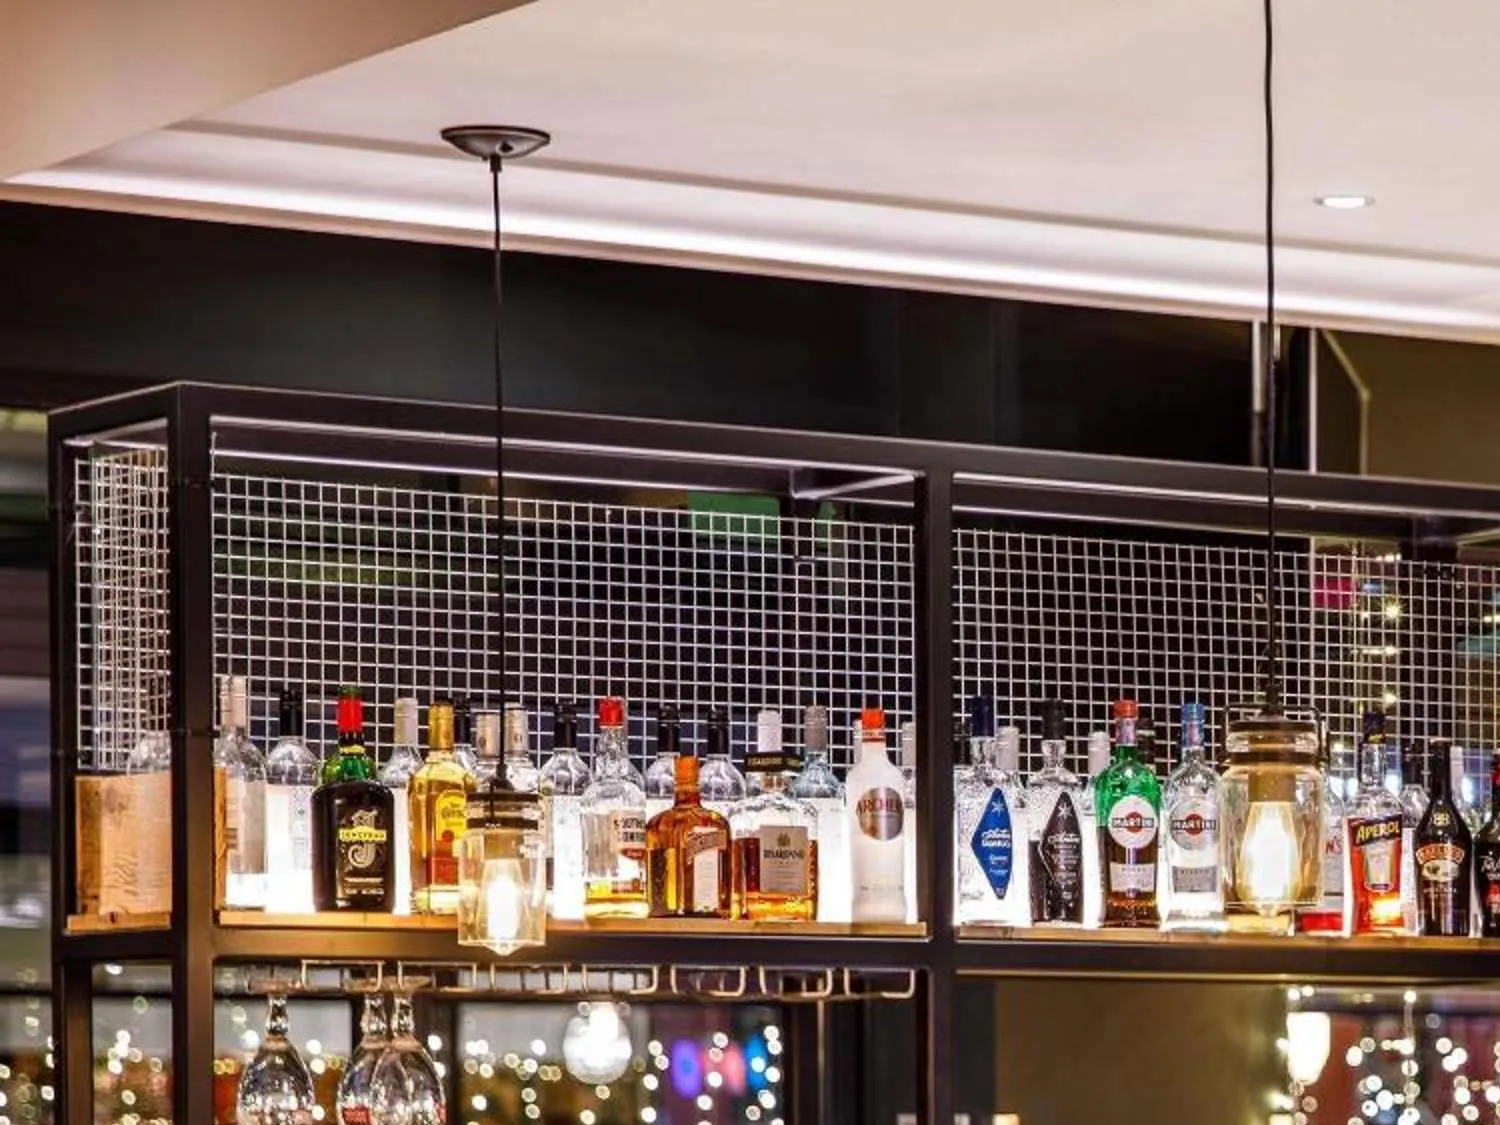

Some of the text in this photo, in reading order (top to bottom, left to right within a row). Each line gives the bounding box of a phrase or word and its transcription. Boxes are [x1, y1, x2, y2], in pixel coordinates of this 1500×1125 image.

[1112, 817, 1155, 829] MARTINI
[1171, 819, 1217, 830] MARTINI
[1355, 820, 1401, 846] APEROL
